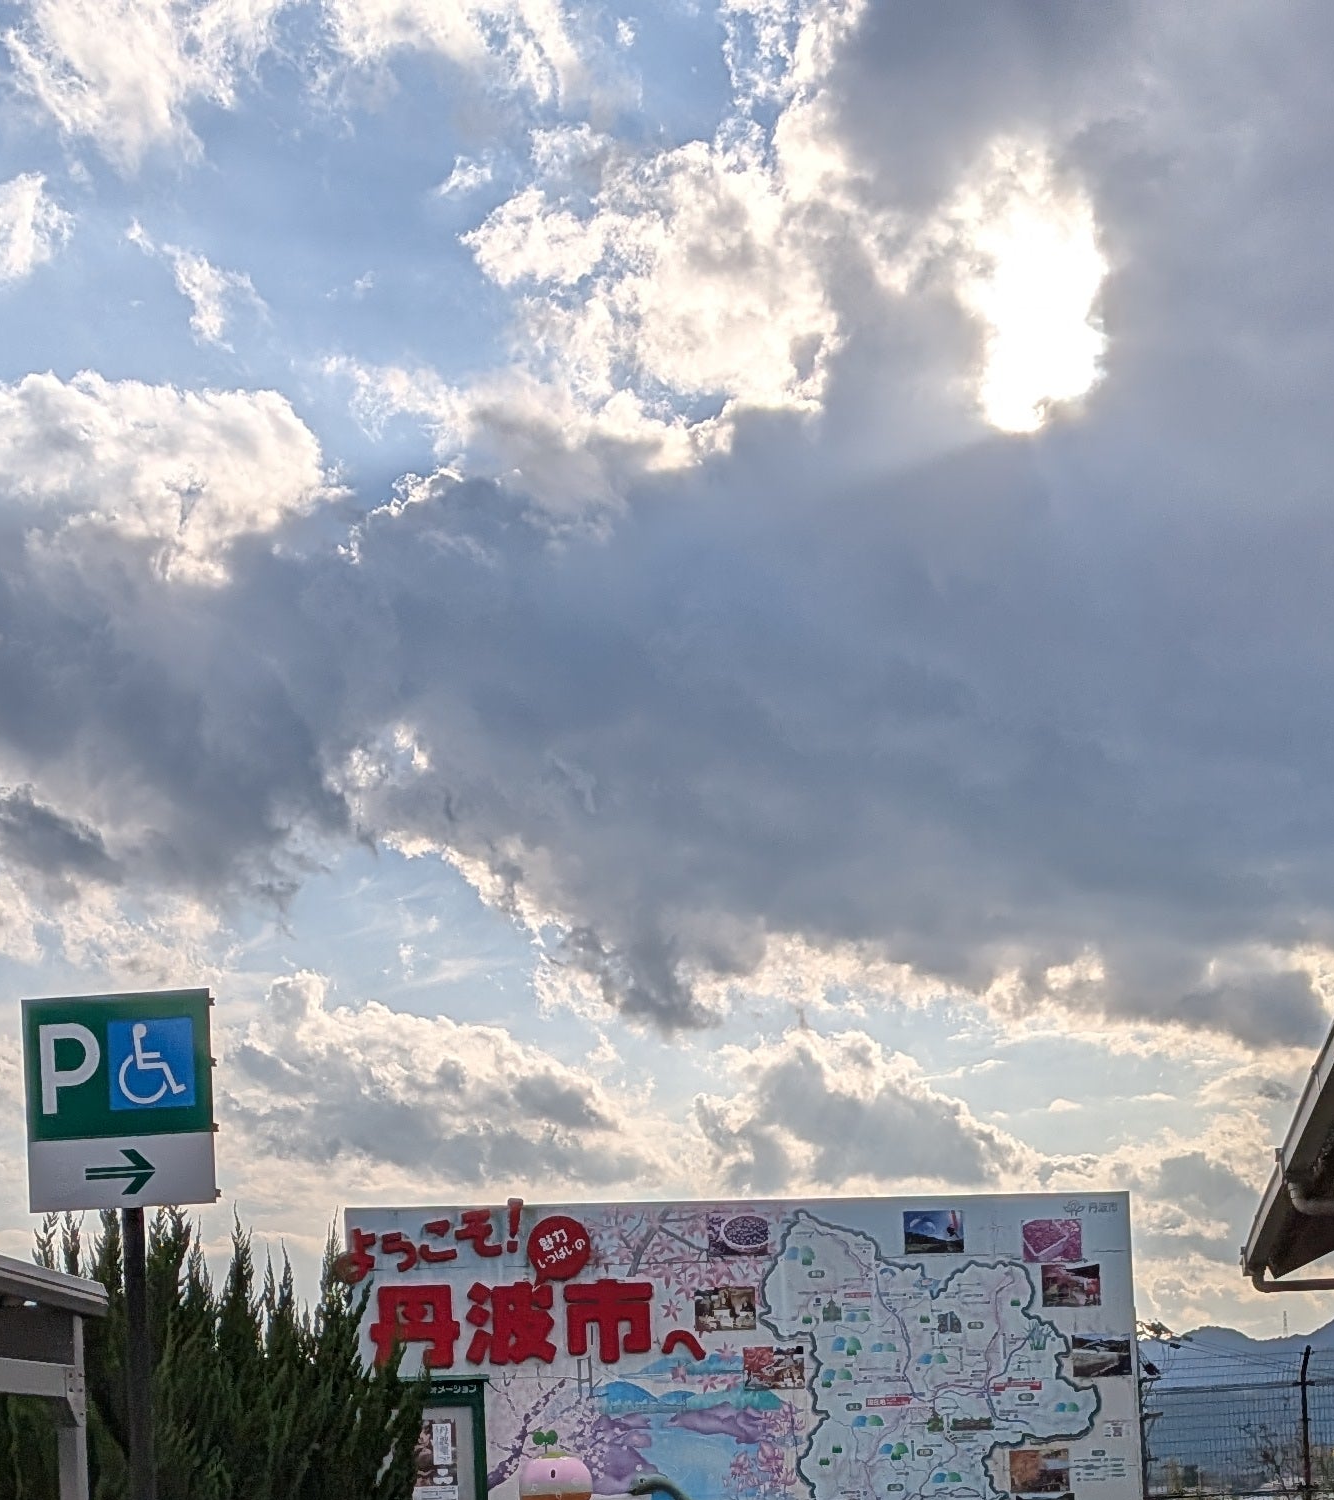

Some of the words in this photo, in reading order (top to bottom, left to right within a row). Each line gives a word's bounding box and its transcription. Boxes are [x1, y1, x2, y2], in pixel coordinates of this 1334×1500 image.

[39, 1023, 100, 1115] P
[538, 1229, 567, 1252] 魅力
[370, 1279, 706, 1370] 丹波市へ
[429, 1384, 477, 1394] ォメーション
